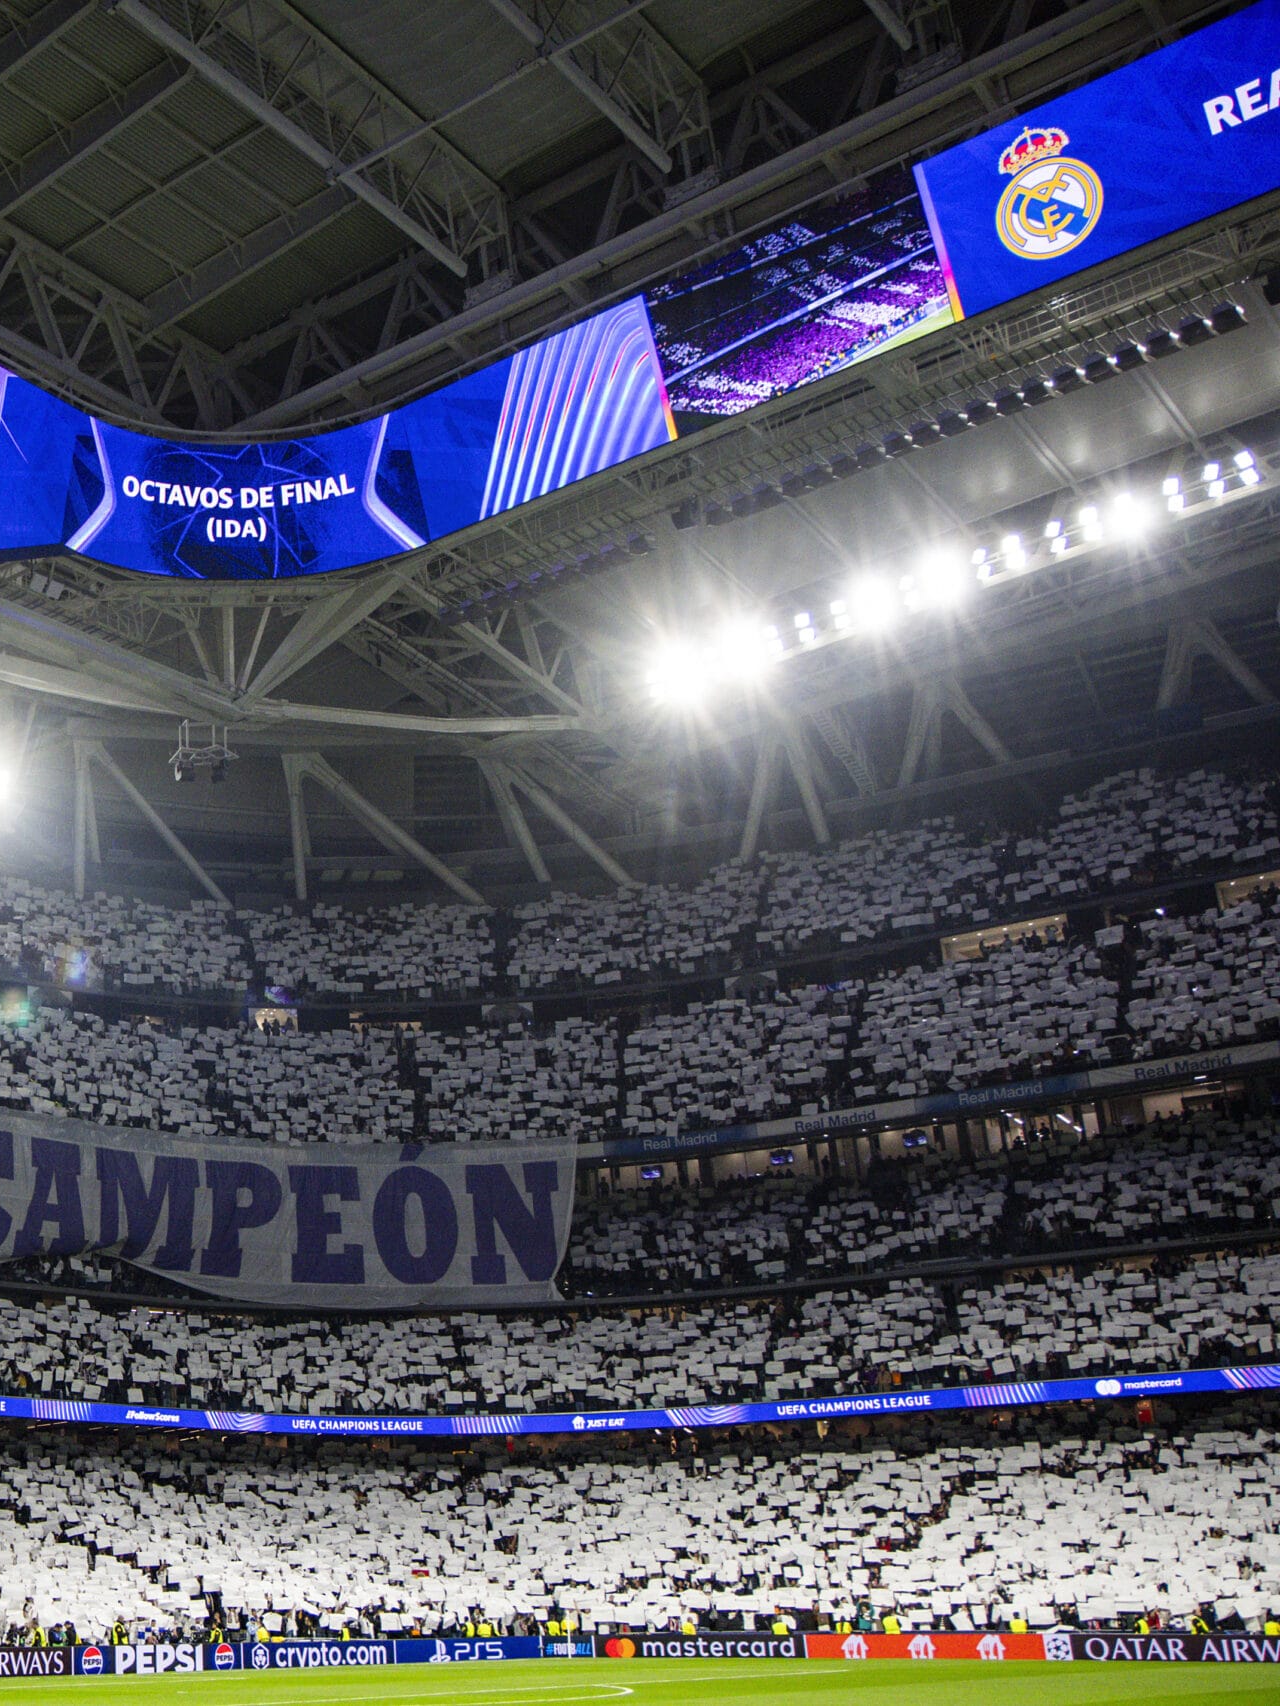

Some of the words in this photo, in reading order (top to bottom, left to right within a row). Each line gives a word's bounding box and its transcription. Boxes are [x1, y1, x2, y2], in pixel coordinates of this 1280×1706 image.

[122, 475, 233, 509] OCTAVOS
[240, 486, 274, 509] DE
[282, 473, 355, 506] FINAL
[206, 517, 267, 542] (IDA)
[1134, 1063, 1170, 1080] Real
[1174, 1053, 1232, 1073] Madrid
[958, 1089, 990, 1106] Real
[993, 1083, 1043, 1100] Madrid
[795, 1117, 824, 1133] Real
[828, 1110, 876, 1128] Madrid
[643, 1135, 671, 1151] Real
[674, 1132, 718, 1147] Madrid
[1124, 1377, 1182, 1390] mastercard
[776, 1404, 807, 1416] UEFA
[809, 1399, 881, 1414] CHAMPIONS
[883, 1395, 932, 1408] LEAGUE
[291, 1419, 317, 1430] UEFA
[318, 1420, 379, 1431] CHAMPIONS
[381, 1421, 423, 1431] LEAGUE
[587, 1419, 607, 1428] JUST
[608, 1417, 625, 1427] EAT
[275, 1643, 387, 1668] crypto.com
[453, 1641, 504, 1661] PS5
[642, 1637, 796, 1657] mastercard
[1085, 1637, 1188, 1661] QATAR
[83, 1658, 102, 1667] PEPSI
[115, 1644, 204, 1675] PEPSI
[216, 1654, 233, 1663] PEPSI
